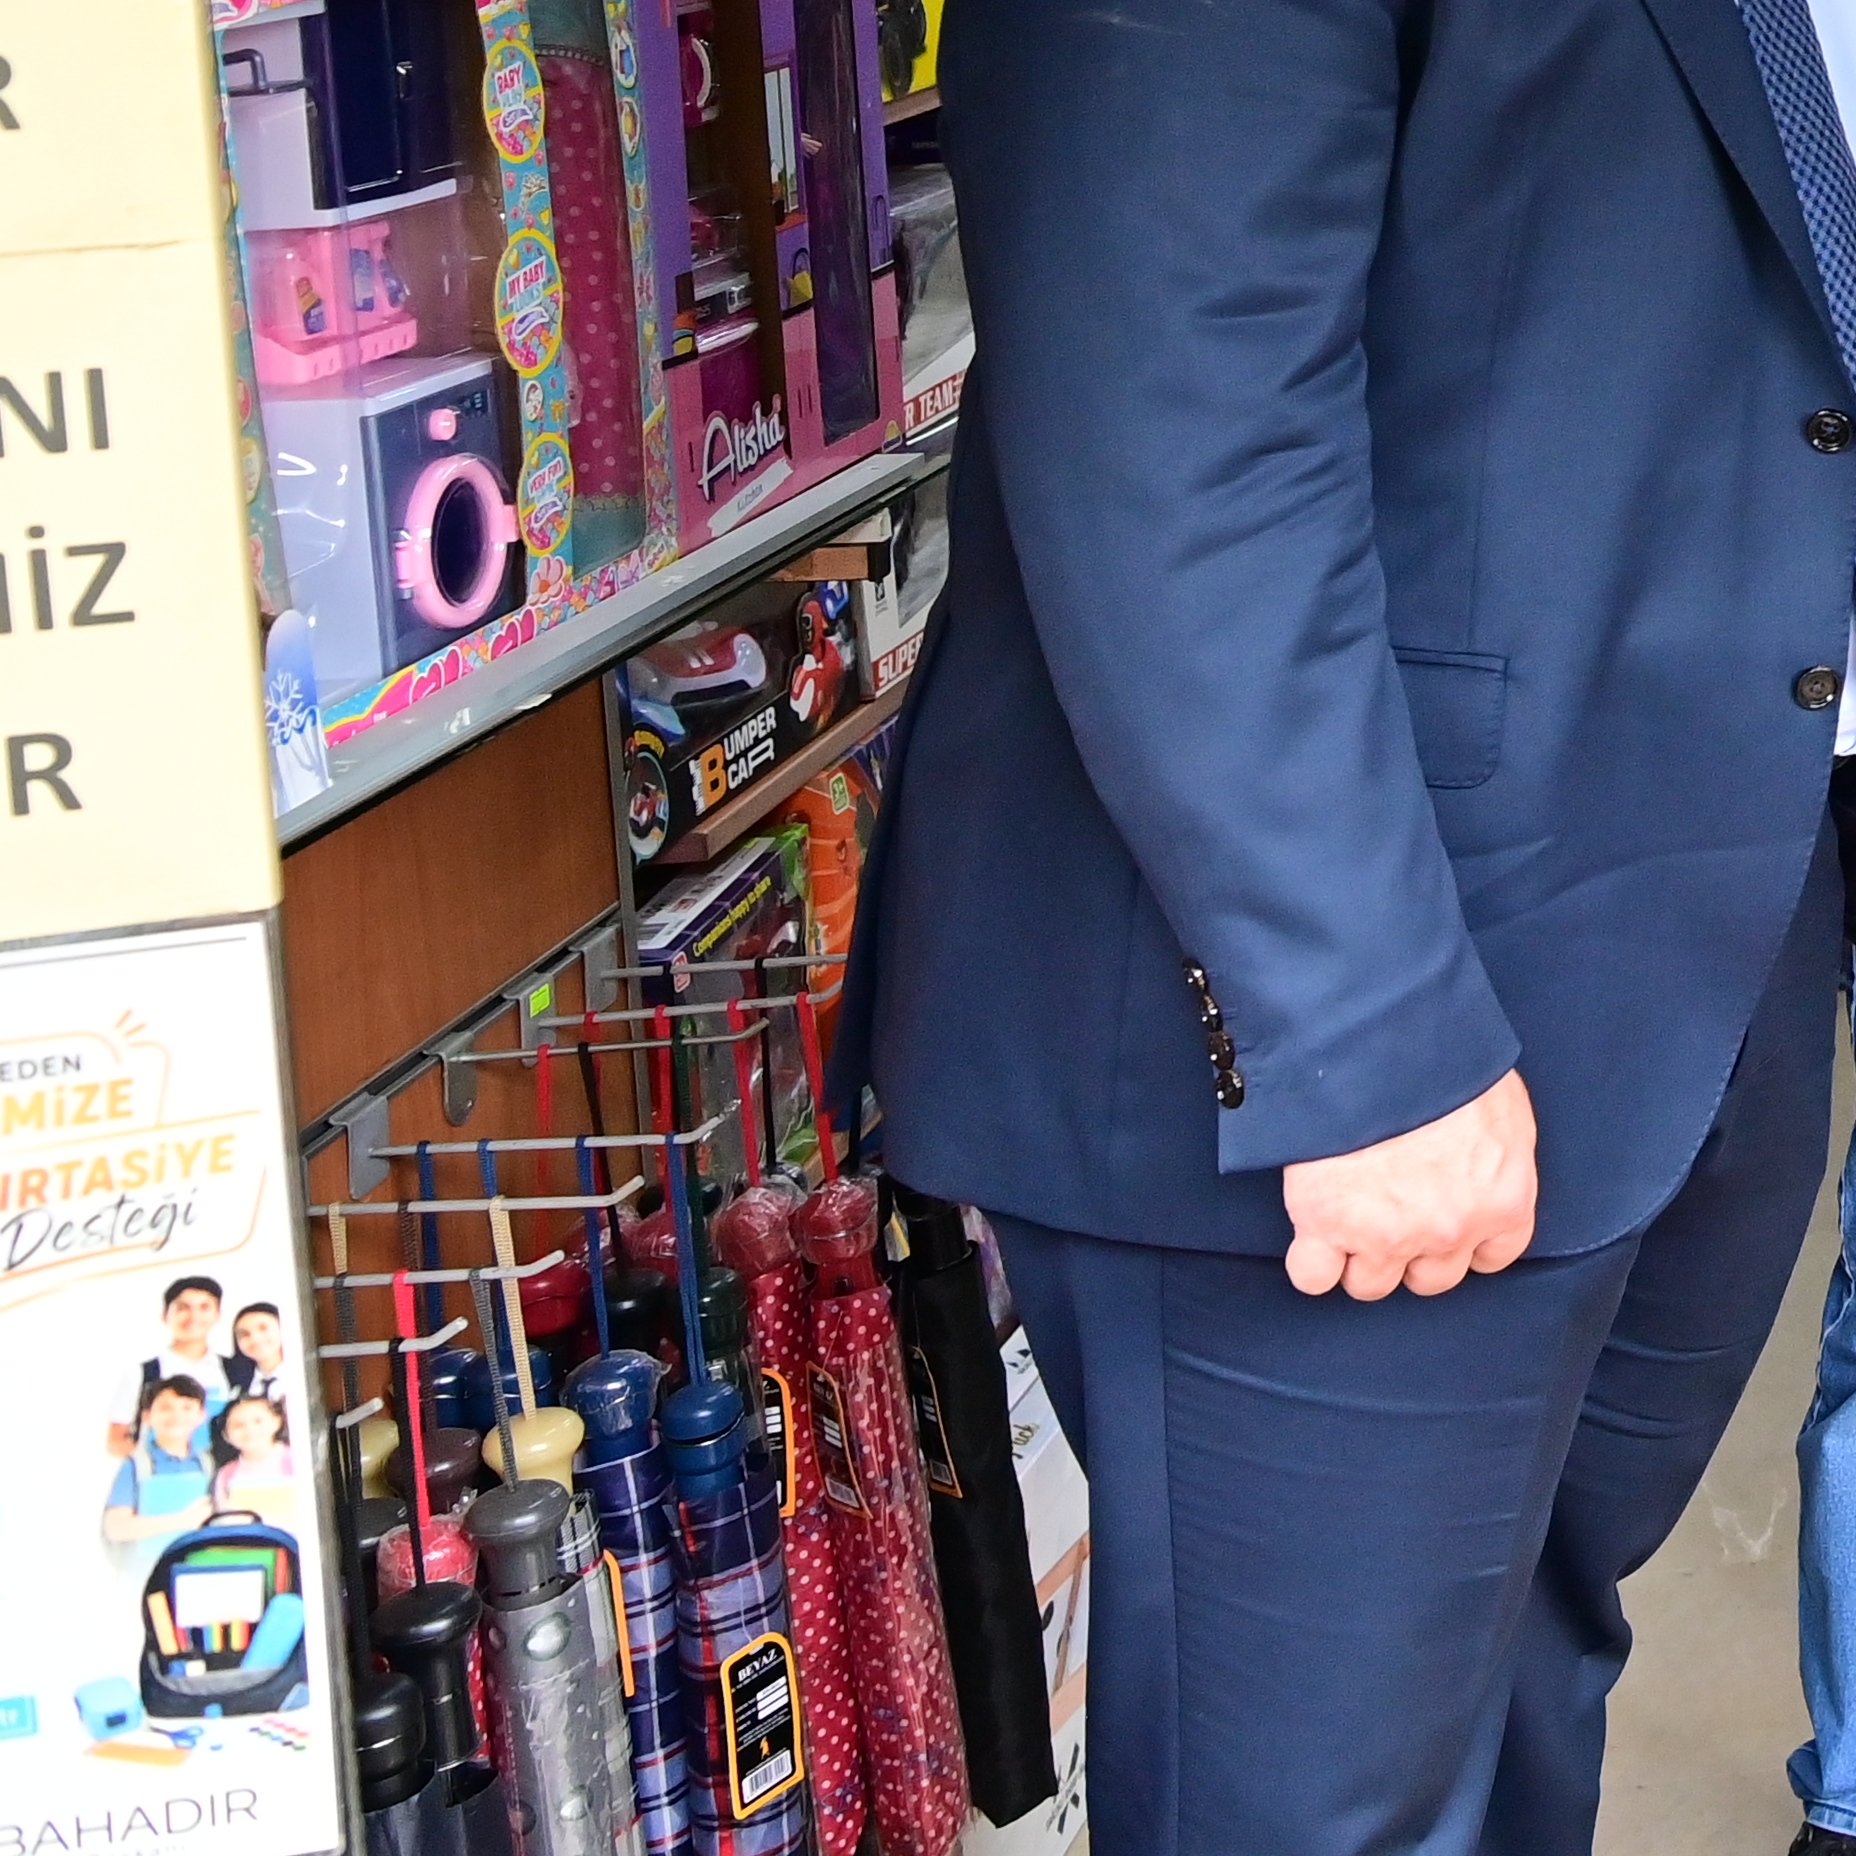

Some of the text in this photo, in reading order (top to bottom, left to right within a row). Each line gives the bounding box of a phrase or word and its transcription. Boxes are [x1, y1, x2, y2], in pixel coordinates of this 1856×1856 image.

[696, 400, 786, 502] Alisha
[0, 524, 136, 634] İZ
[8, 730, 83, 818] R
[700, 705, 778, 809] BUMPER
[727, 737, 776, 790] CAR
[1, 1077, 134, 1136] MİZE
[0, 1186, 199, 1273] Desteği
[736, 1647, 778, 1684] BEYAZ
